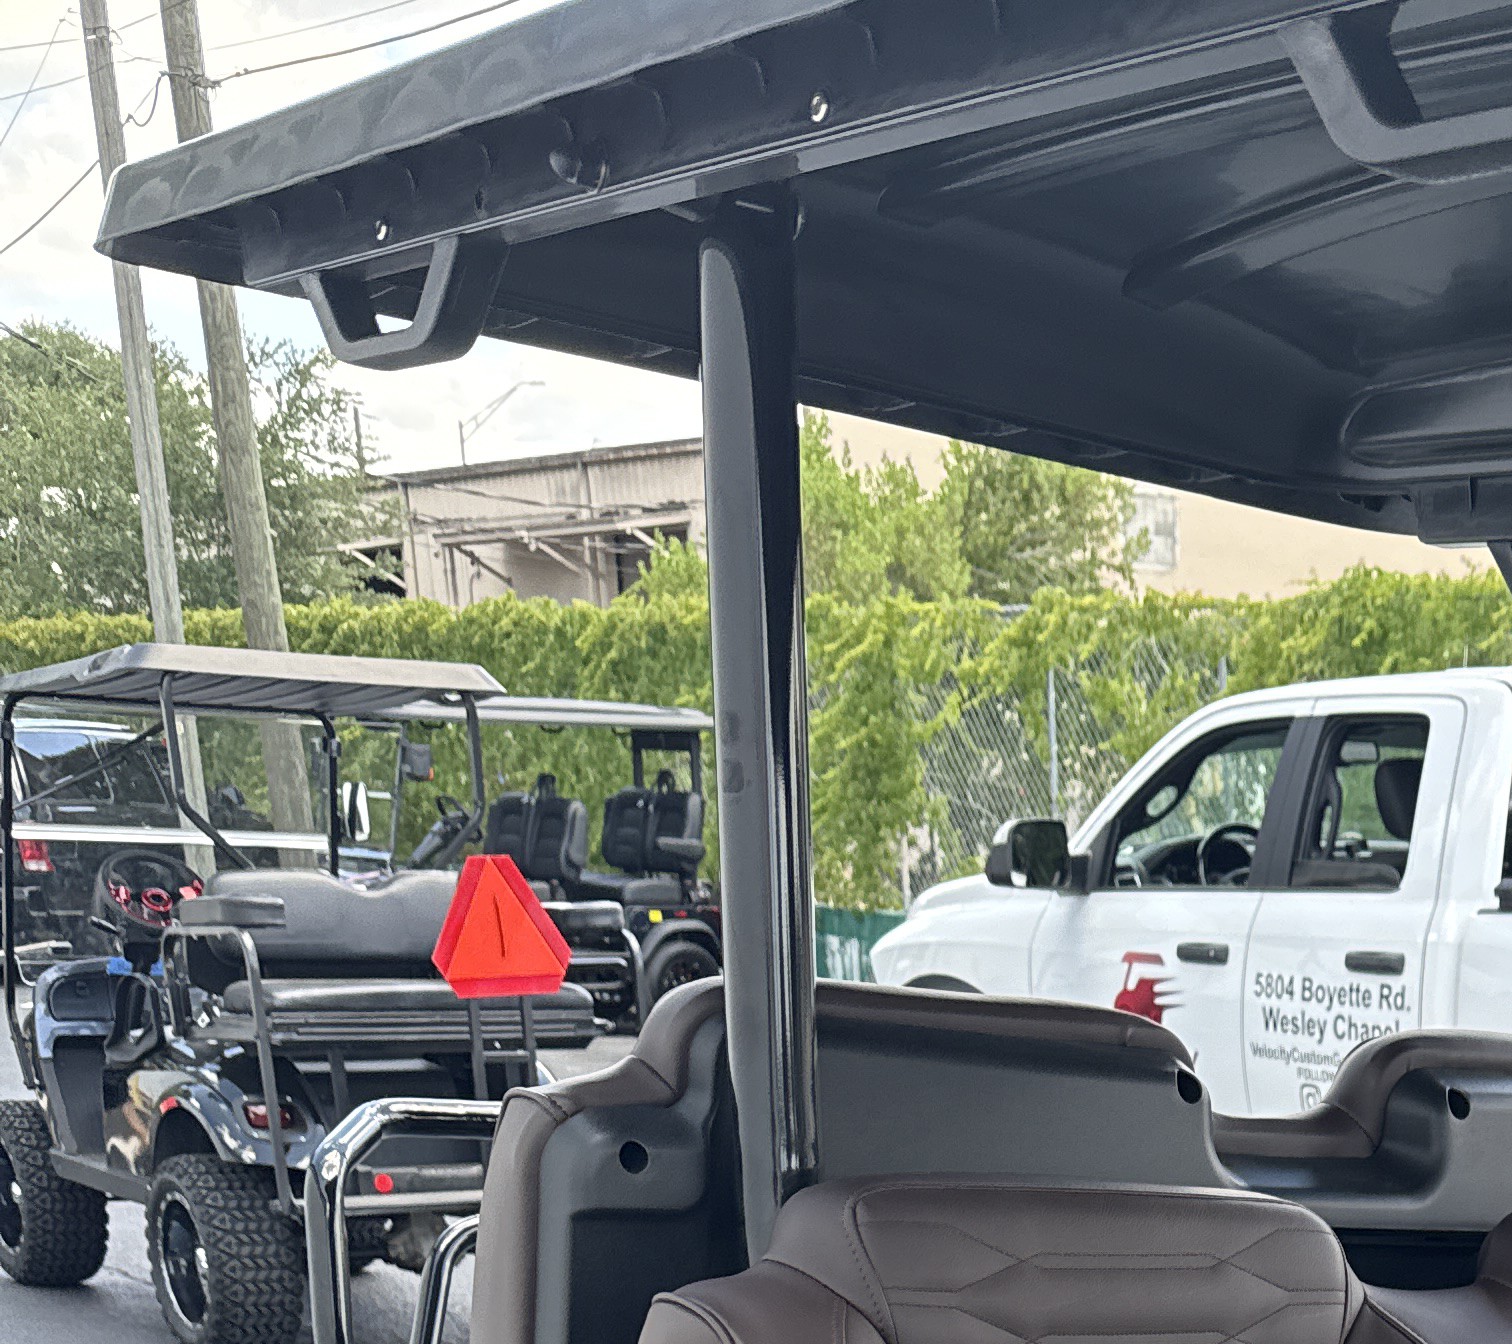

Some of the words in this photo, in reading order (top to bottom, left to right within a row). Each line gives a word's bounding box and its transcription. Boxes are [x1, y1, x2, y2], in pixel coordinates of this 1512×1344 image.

[1253, 972, 1295, 1001] 5804
[1301, 976, 1373, 1012] Boyette
[1378, 983, 1412, 1013] Rd.
[1262, 1005, 1328, 1045] Wesley
